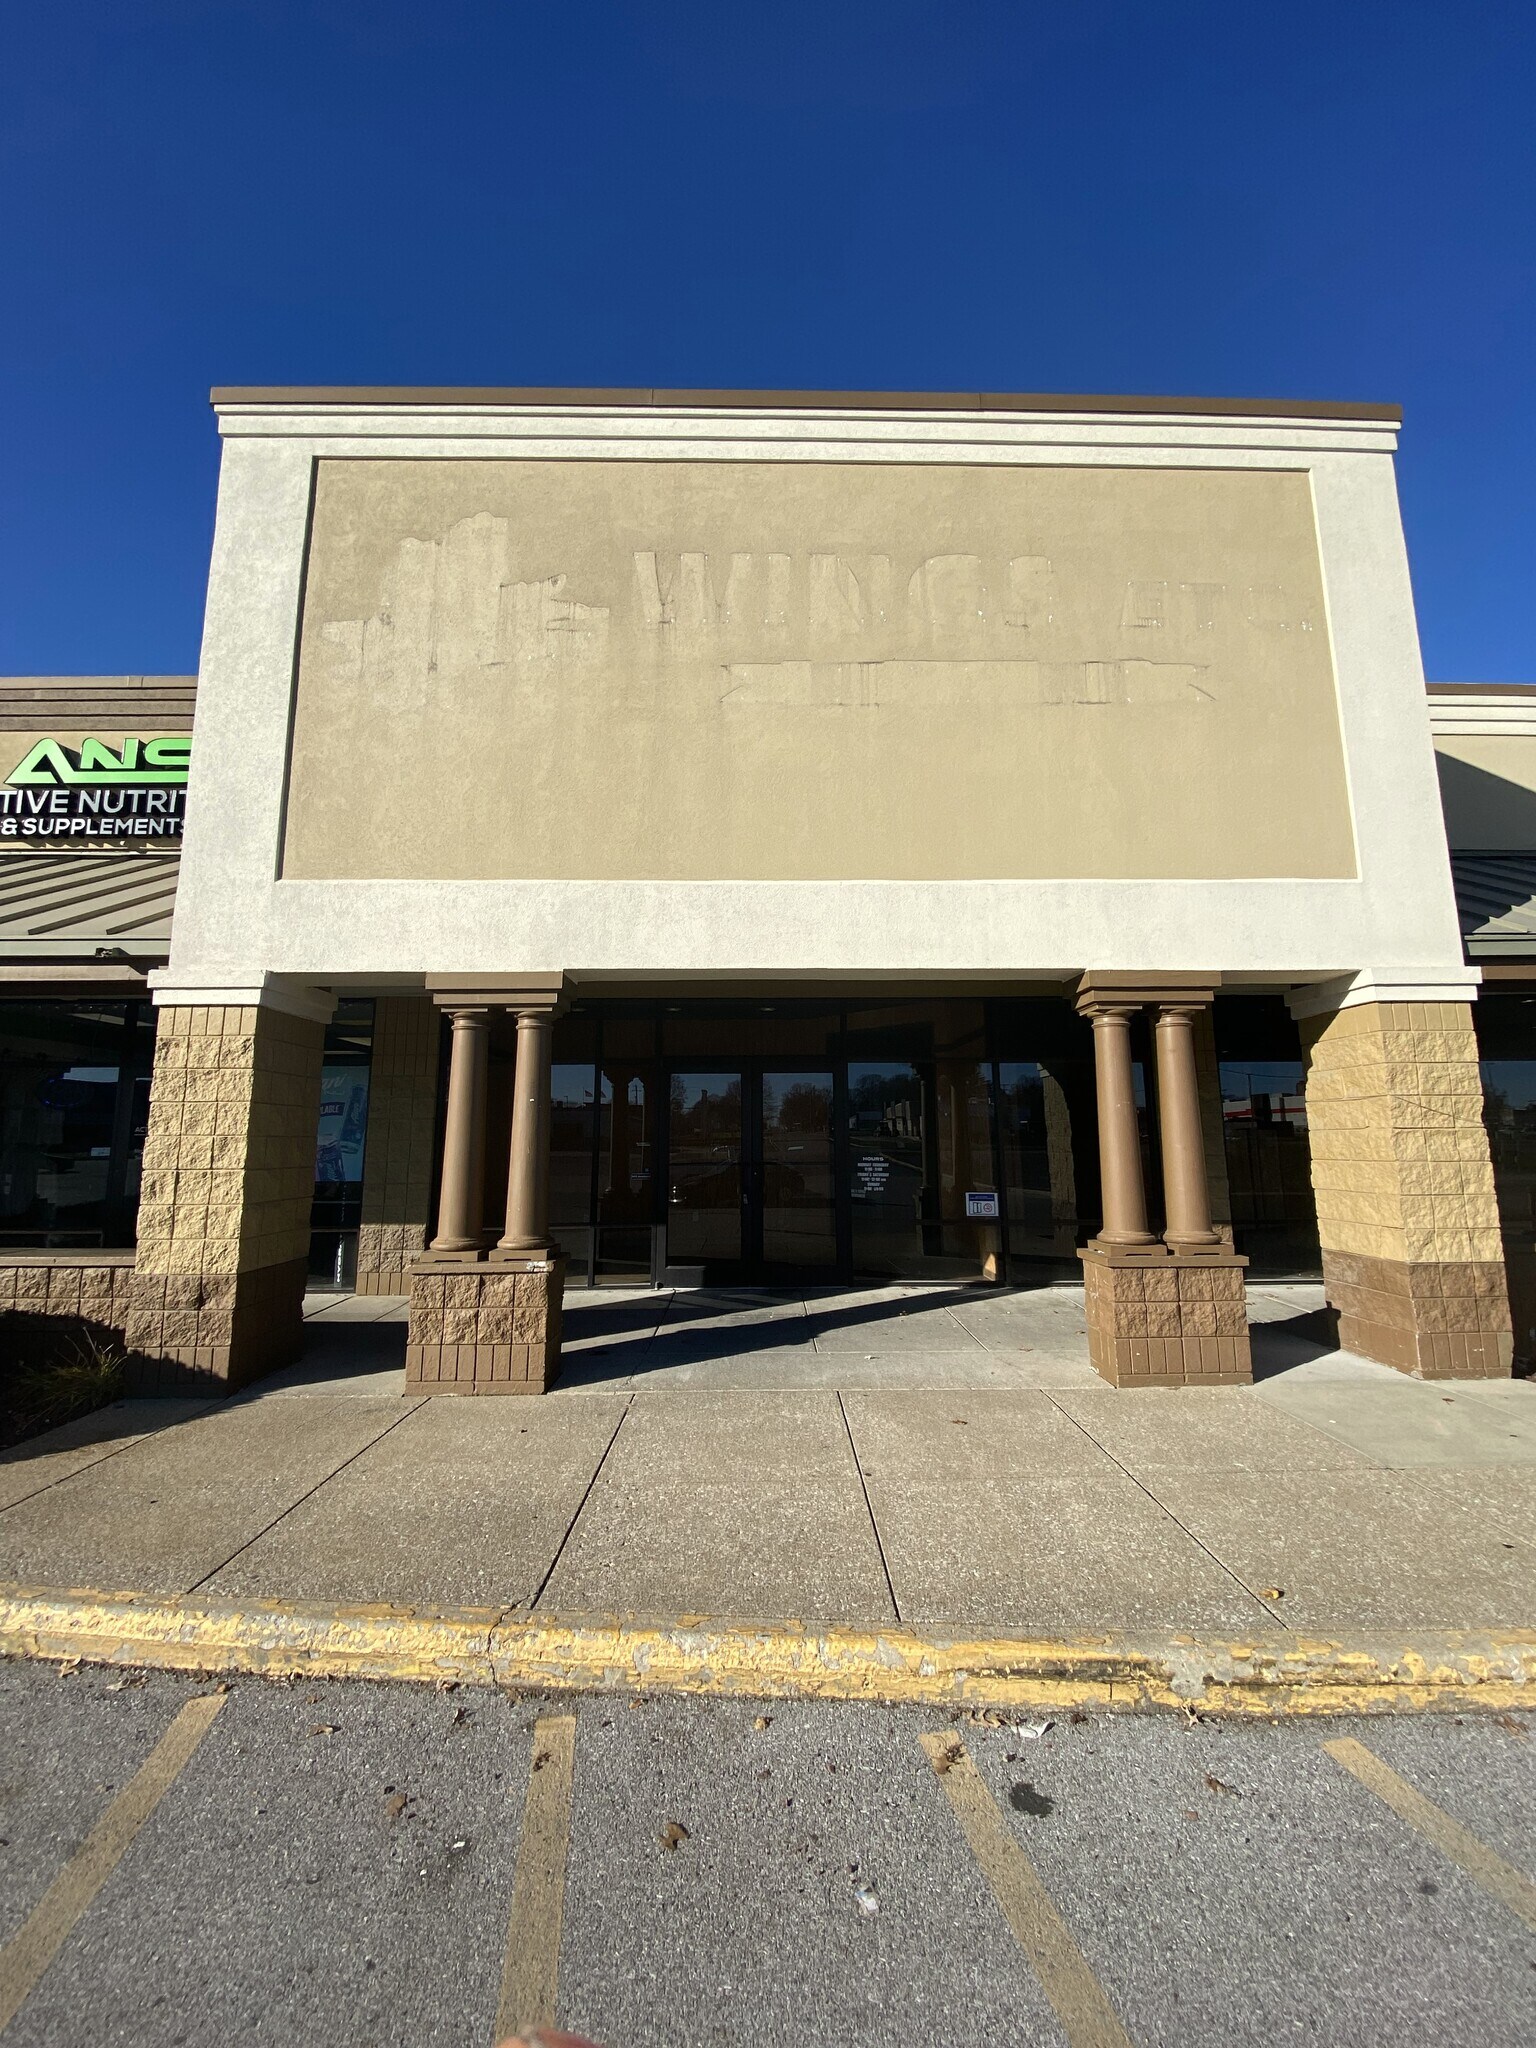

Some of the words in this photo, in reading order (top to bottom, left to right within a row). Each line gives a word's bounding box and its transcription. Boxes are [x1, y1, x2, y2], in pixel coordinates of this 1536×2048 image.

[0, 790, 69, 813] TIVE
[1, 818, 18, 835] &
[22, 818, 184, 835] SUPPLEMENT
